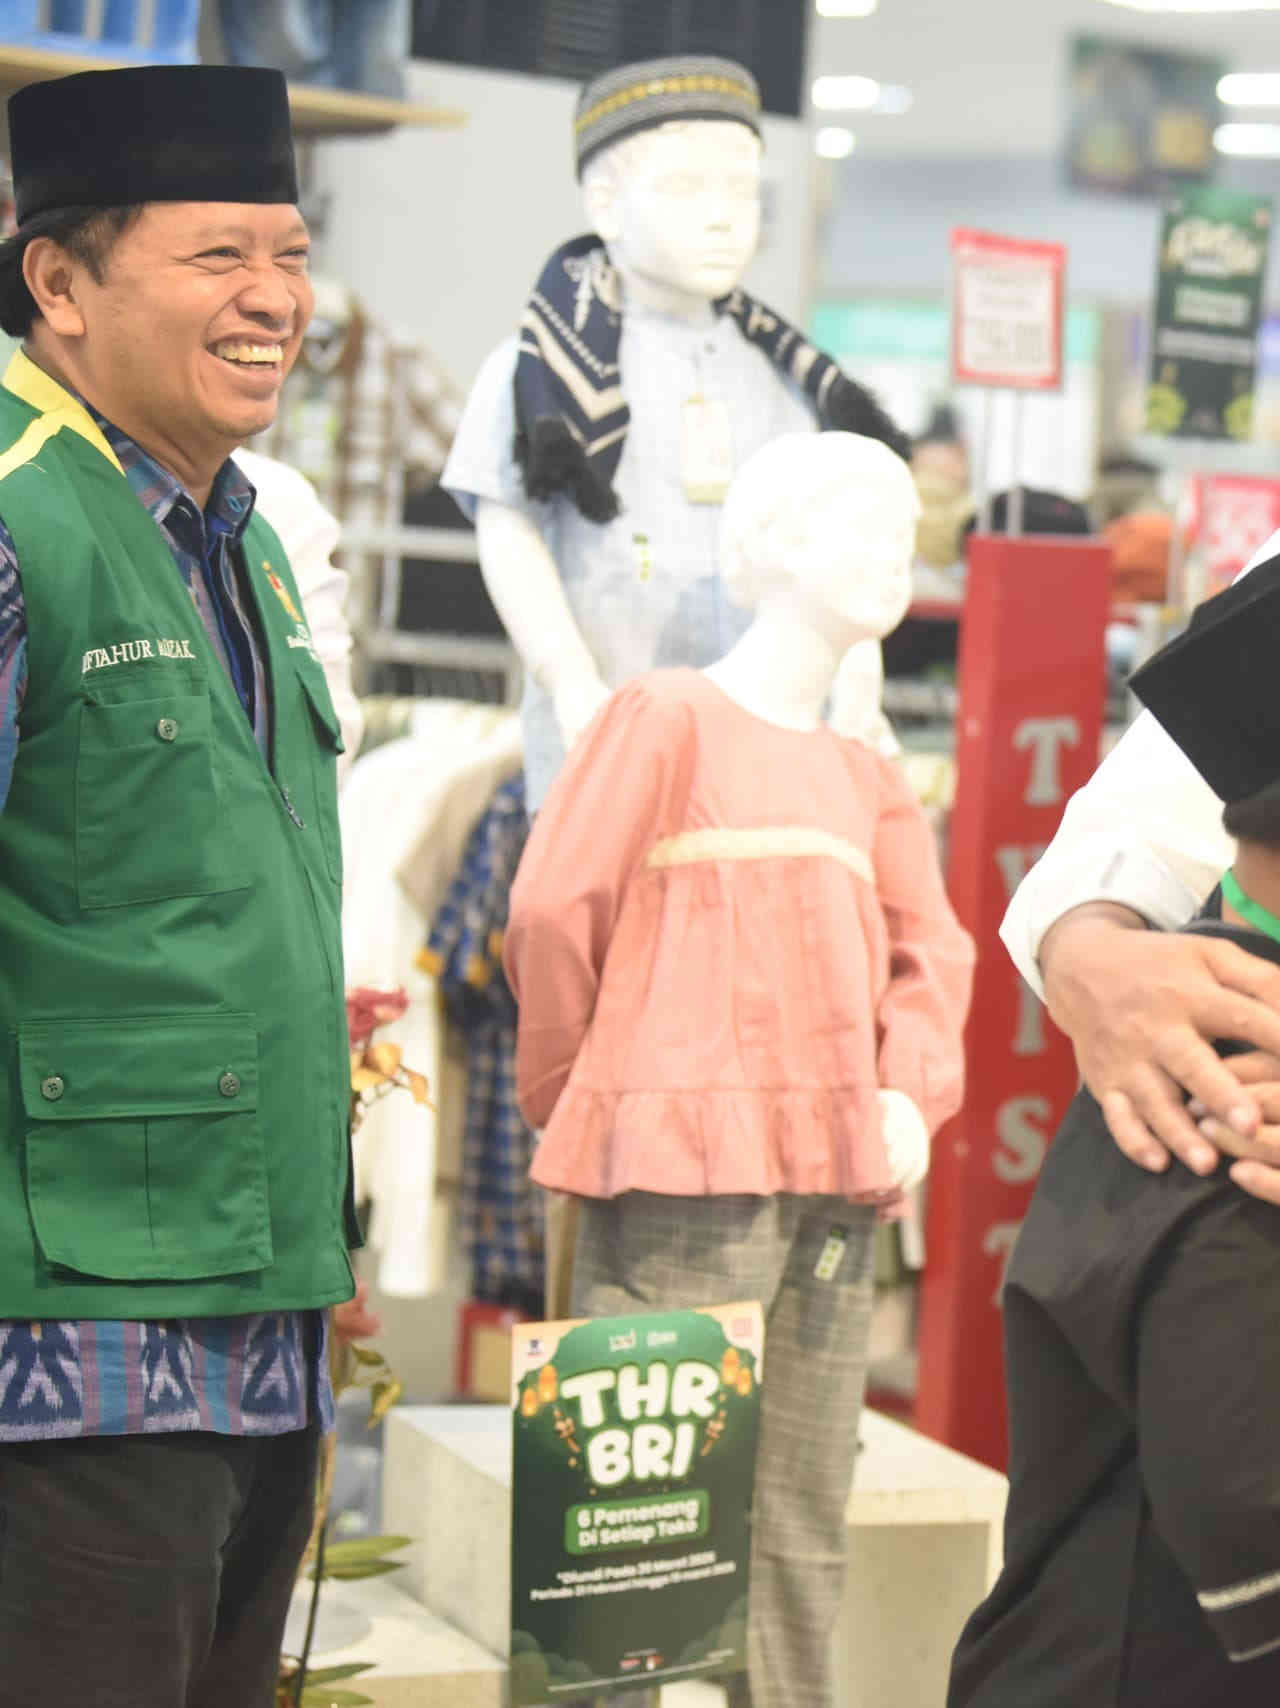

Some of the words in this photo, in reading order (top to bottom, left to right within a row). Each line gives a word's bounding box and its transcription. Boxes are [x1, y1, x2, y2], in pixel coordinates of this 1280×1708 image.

[560, 1360, 720, 1429] THR
[587, 1422, 695, 1487] BRI
[577, 1529, 598, 1548] Di
[599, 1525, 656, 1545] Setiap
[656, 1518, 699, 1538] Toko
[593, 1499, 699, 1527] Pemenang
